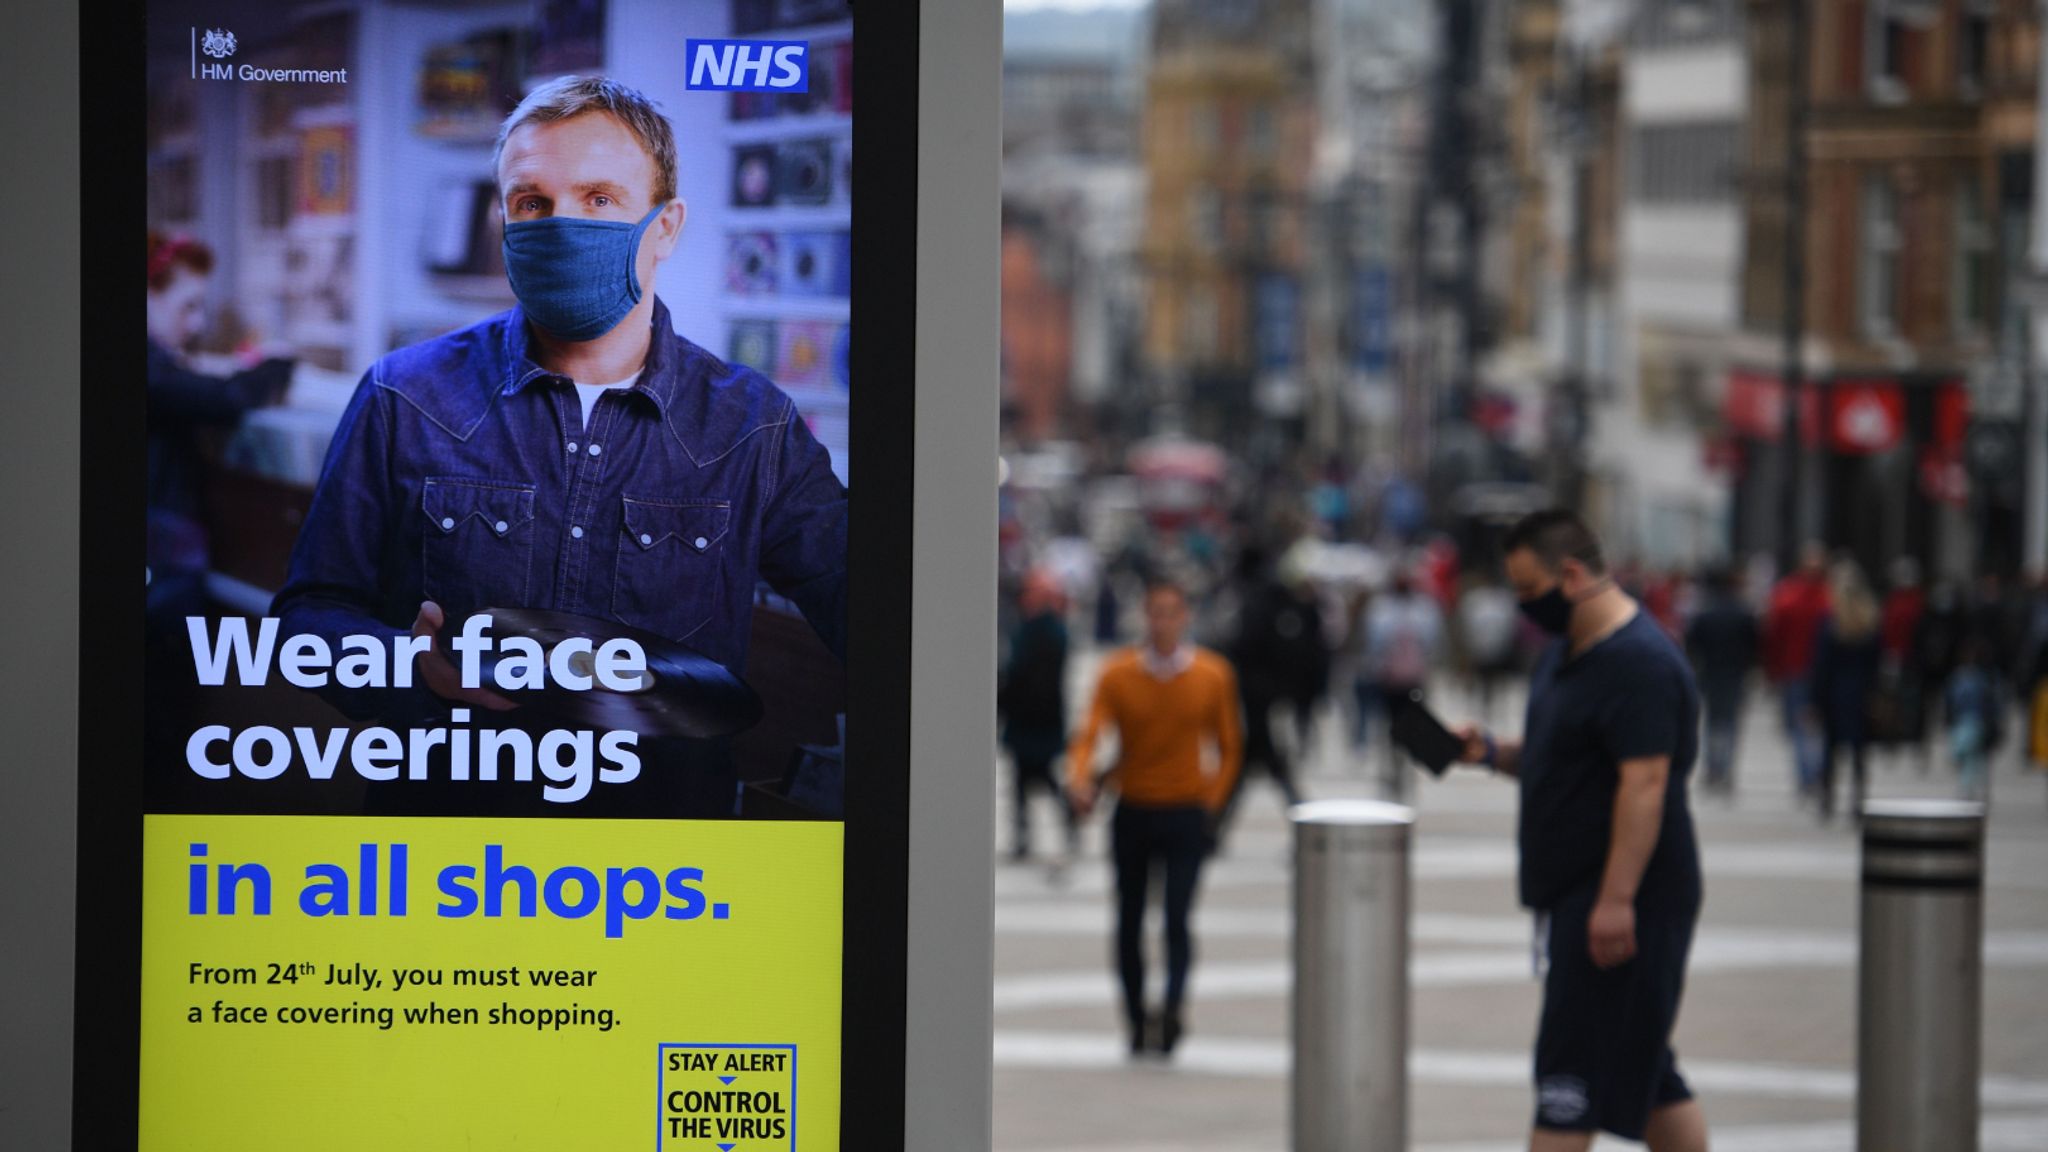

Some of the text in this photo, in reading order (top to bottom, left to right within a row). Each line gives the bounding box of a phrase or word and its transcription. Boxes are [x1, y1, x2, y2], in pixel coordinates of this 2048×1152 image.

[201, 63, 347, 84] HM Government
[690, 44, 805, 88] NHS
[185, 613, 647, 692] Wear face
[185, 708, 642, 803] coverings
[188, 842, 730, 939] in all shops.
[189, 961, 598, 992] From 24th July, you must wear
[187, 1000, 621, 1032] a face covering when shopping.
[668, 1053, 787, 1072] STAY ALERT
[667, 1090, 786, 1114] CONTROL
[668, 1117, 786, 1140] THE VIRUS
